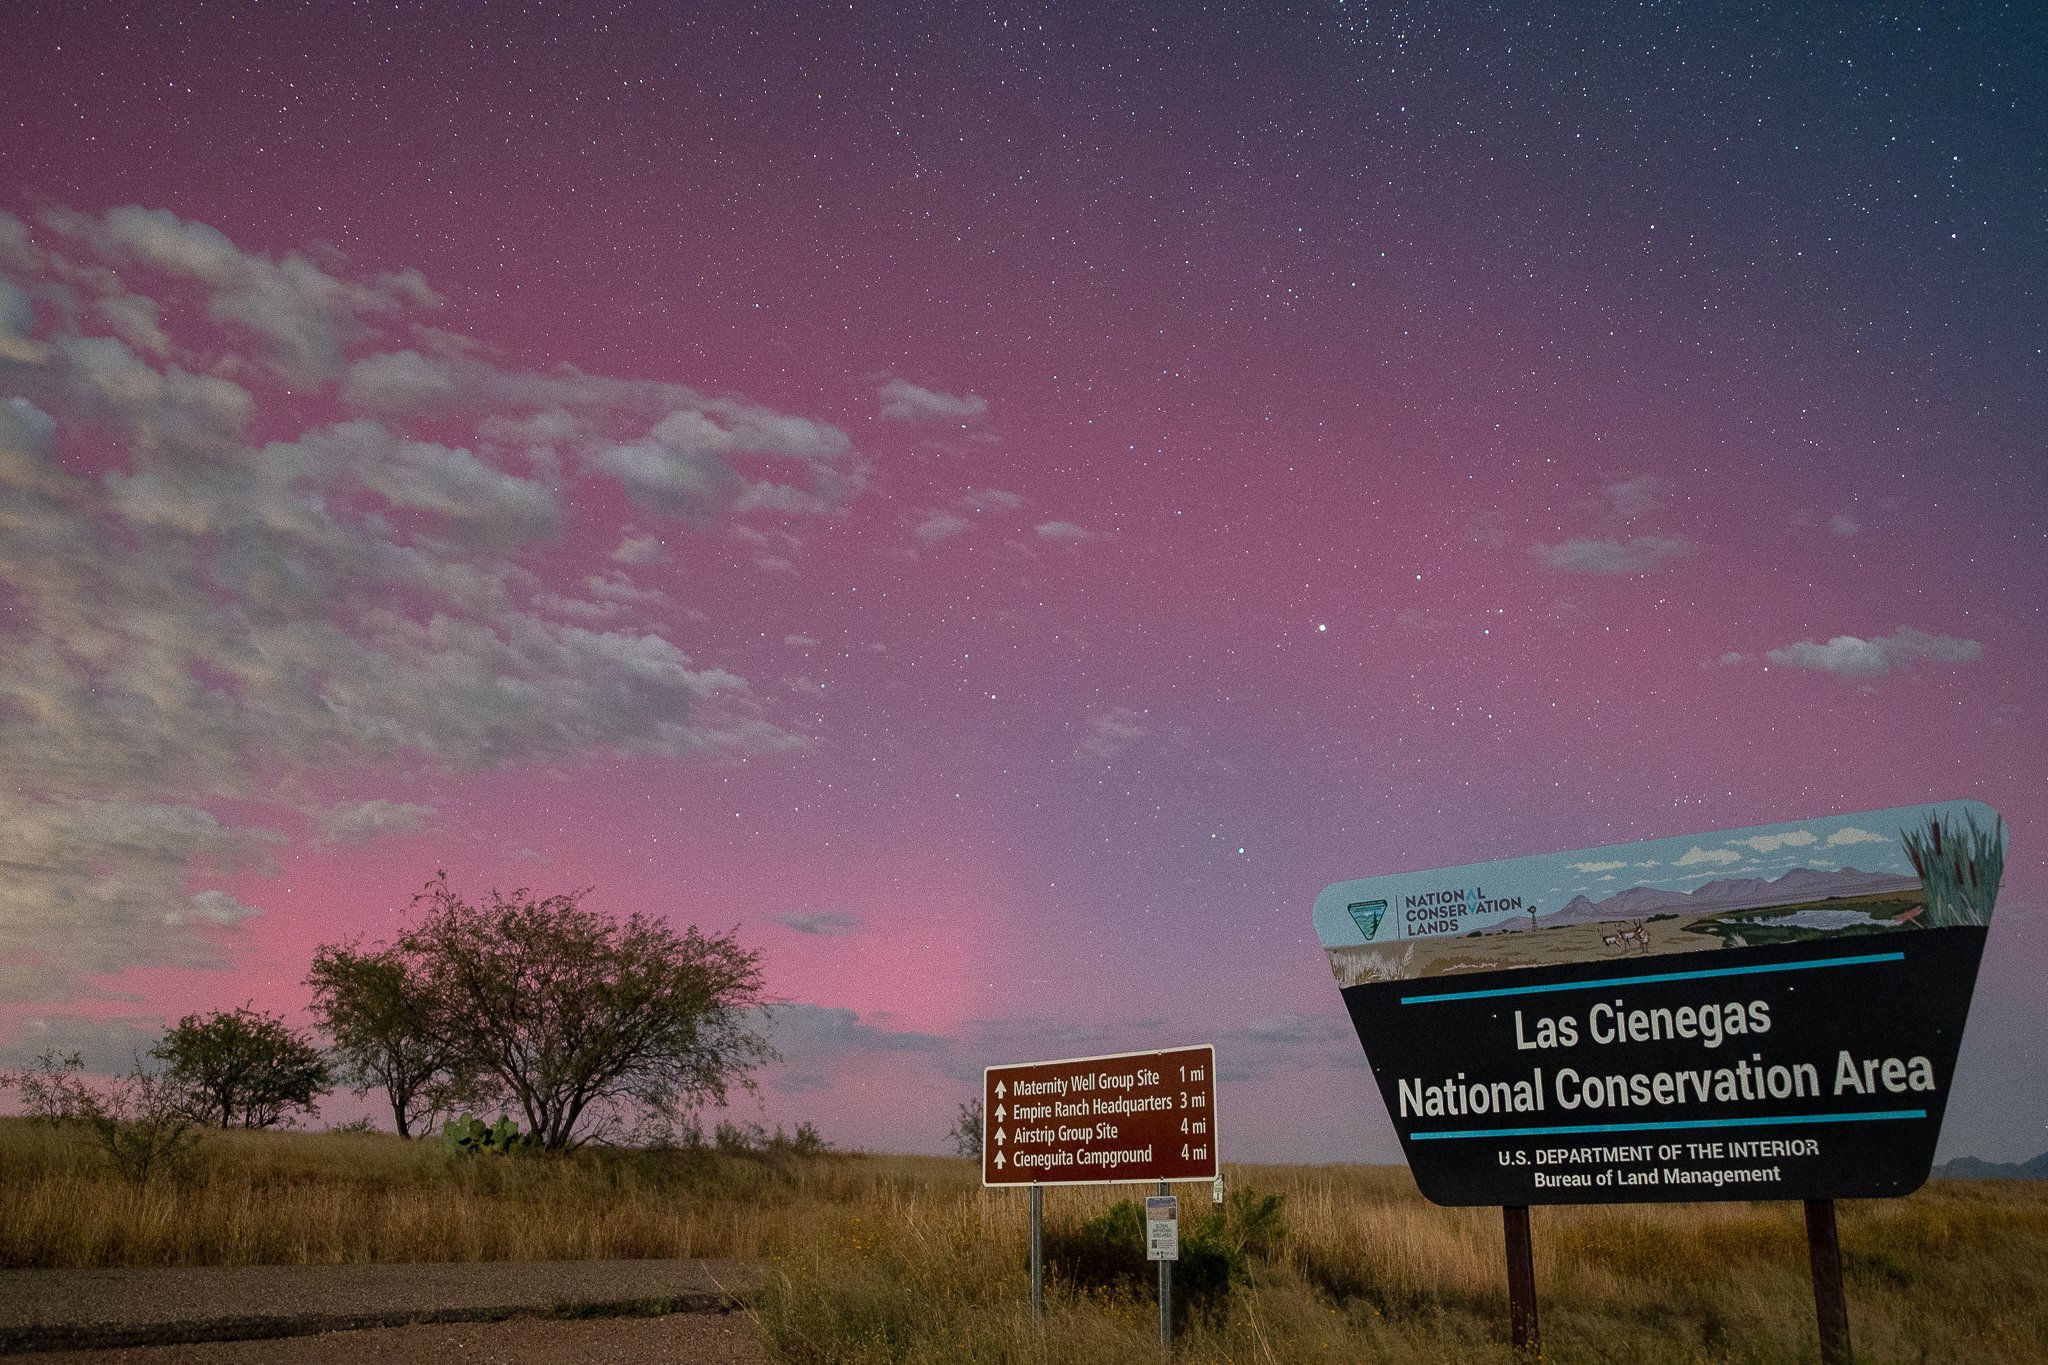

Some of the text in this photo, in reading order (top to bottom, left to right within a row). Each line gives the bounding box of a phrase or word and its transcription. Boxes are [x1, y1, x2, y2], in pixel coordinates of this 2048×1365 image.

[1406, 887, 1485, 907] NATIONAL
[1406, 897, 1522, 922] CONSERVATION
[1408, 919, 1458, 936] LANDS
[1515, 998, 1772, 1050] Las Cienegas
[1013, 1065, 1204, 1097] Maternity Well Group Site 1 mi
[1398, 1050, 1935, 1118] National Conservation Area
[1013, 1092, 1205, 1122] Empire Ranch Headquarters 3 mi
[1014, 1118, 1206, 1146] Airstrip Group Site 4 mi
[1013, 1144, 1207, 1171] Cieneguita Campground 4 mi
[1498, 1139, 1819, 1167] U.S. DEPARTMENT OF THE INTERIOR
[1534, 1166, 1781, 1188] Bureau of Land Management
